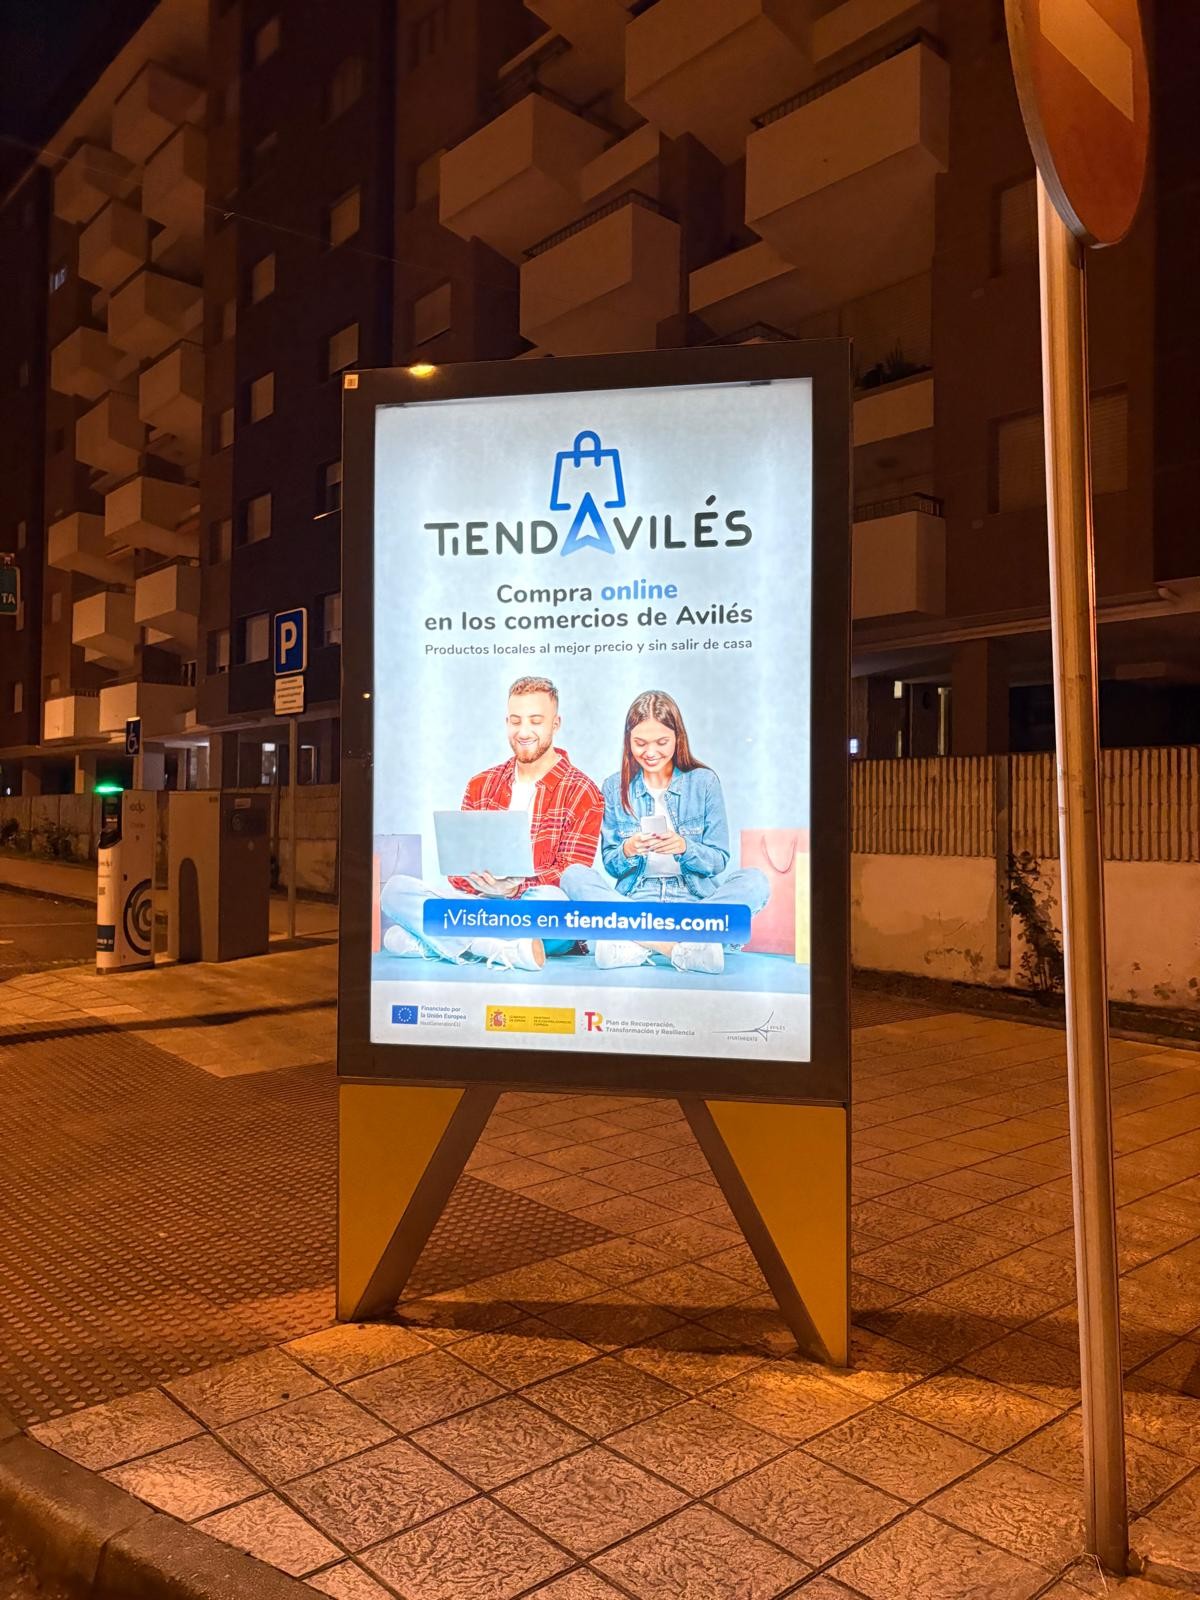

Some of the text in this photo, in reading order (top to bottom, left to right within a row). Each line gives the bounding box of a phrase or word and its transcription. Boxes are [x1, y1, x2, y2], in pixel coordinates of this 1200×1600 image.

[496, 578, 678, 607] Compra online
[424, 602, 753, 631] en los comercios de Avilés
[281, 621, 298, 664] P
[424, 638, 753, 656] Productos locales al mejor precio y sin salir de casa
[443, 908, 730, 932] ¡Visítanos en tiendaviles.com!
[606, 1026, 654, 1034] Transformación
[630, 1020, 675, 1029] Recuperación,
